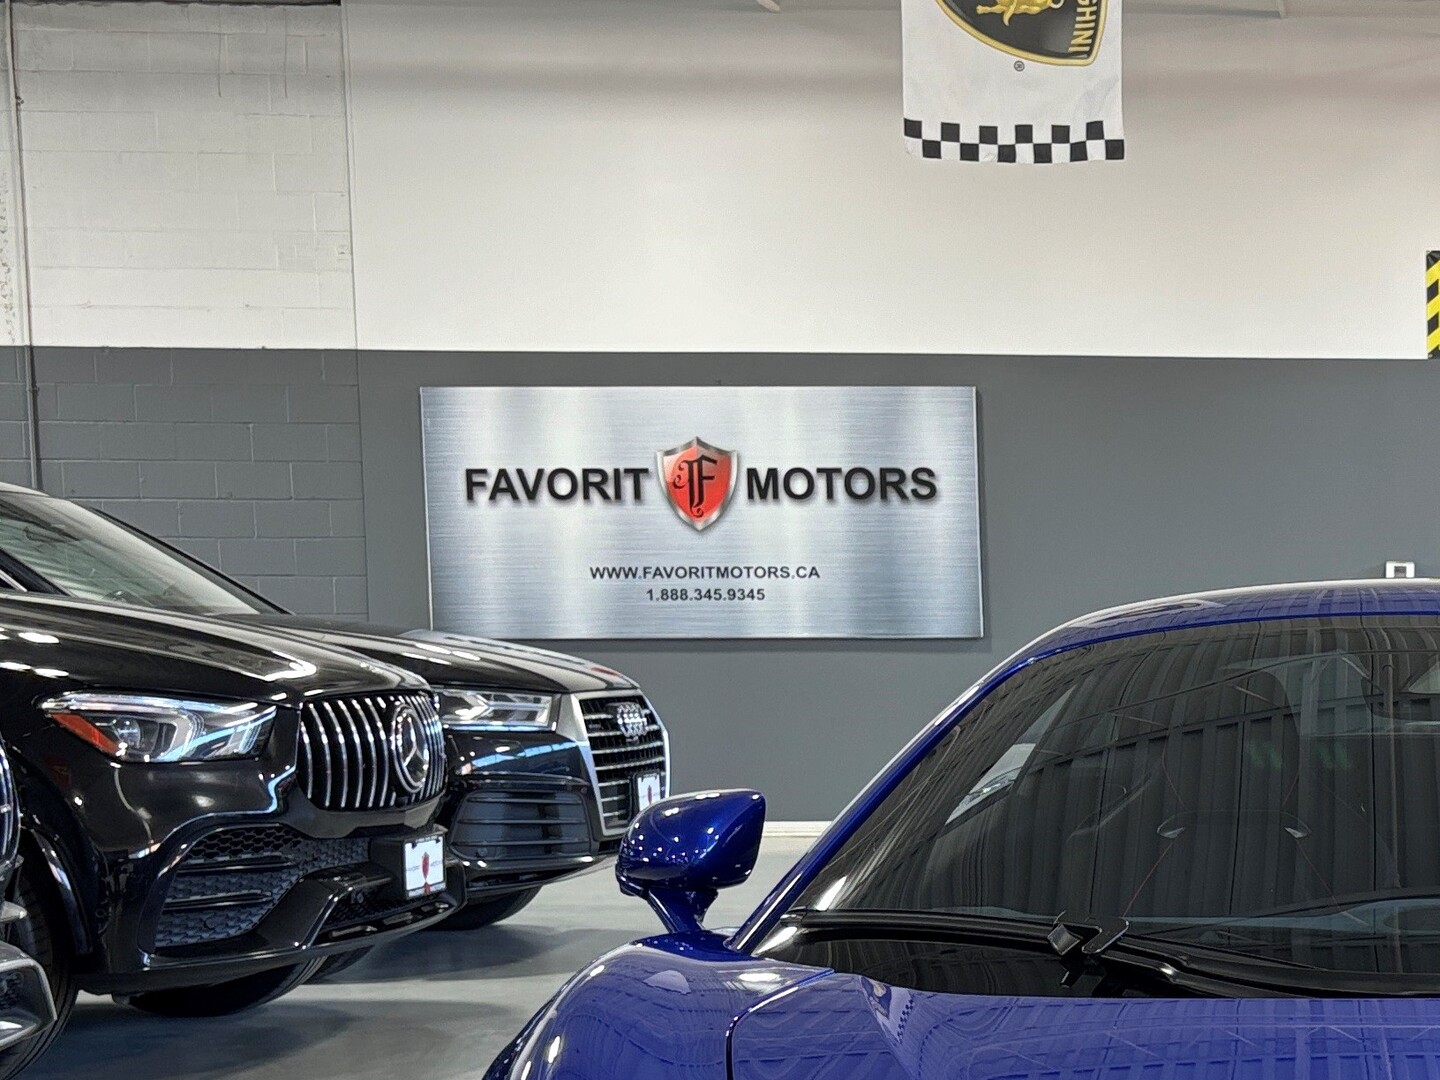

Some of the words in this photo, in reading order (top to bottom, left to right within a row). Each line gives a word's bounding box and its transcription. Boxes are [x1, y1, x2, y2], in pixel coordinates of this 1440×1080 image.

[465, 468, 649, 502] FAVORIT
[747, 466, 938, 502] MOTORS
[590, 566, 821, 579] WWW.FAVORITMOTORS.CA
[646, 588, 765, 601] 1.888.345.9345
